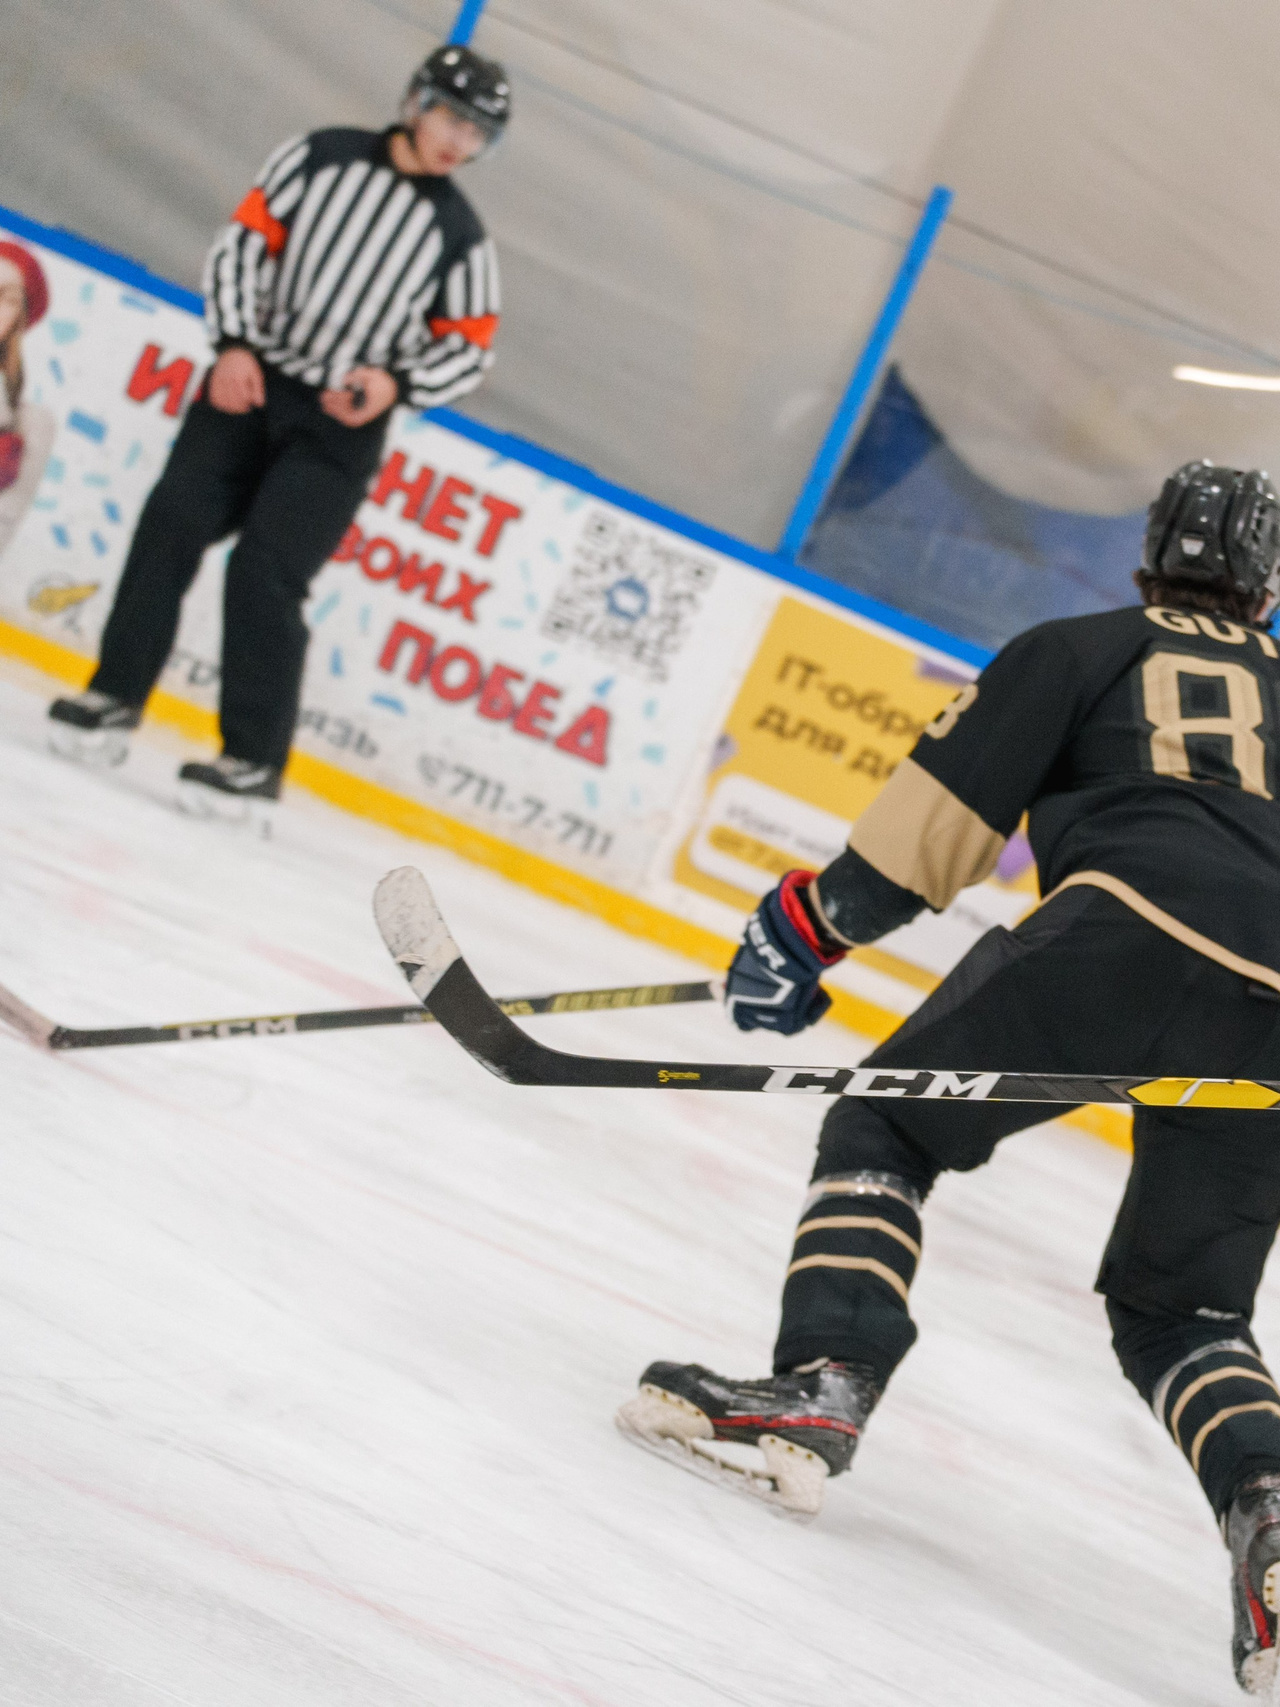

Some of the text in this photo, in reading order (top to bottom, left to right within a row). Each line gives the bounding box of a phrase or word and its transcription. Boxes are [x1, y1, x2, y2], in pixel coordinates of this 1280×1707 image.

[331, 522, 492, 624] ВОИХ
[378, 620, 613, 767] ПОБЕД
[774, 653, 926, 738] IT-обр
[755, 703, 847, 755] для
[178, 1016, 299, 1041] CCM
[762, 1066, 1002, 1099] CCM
